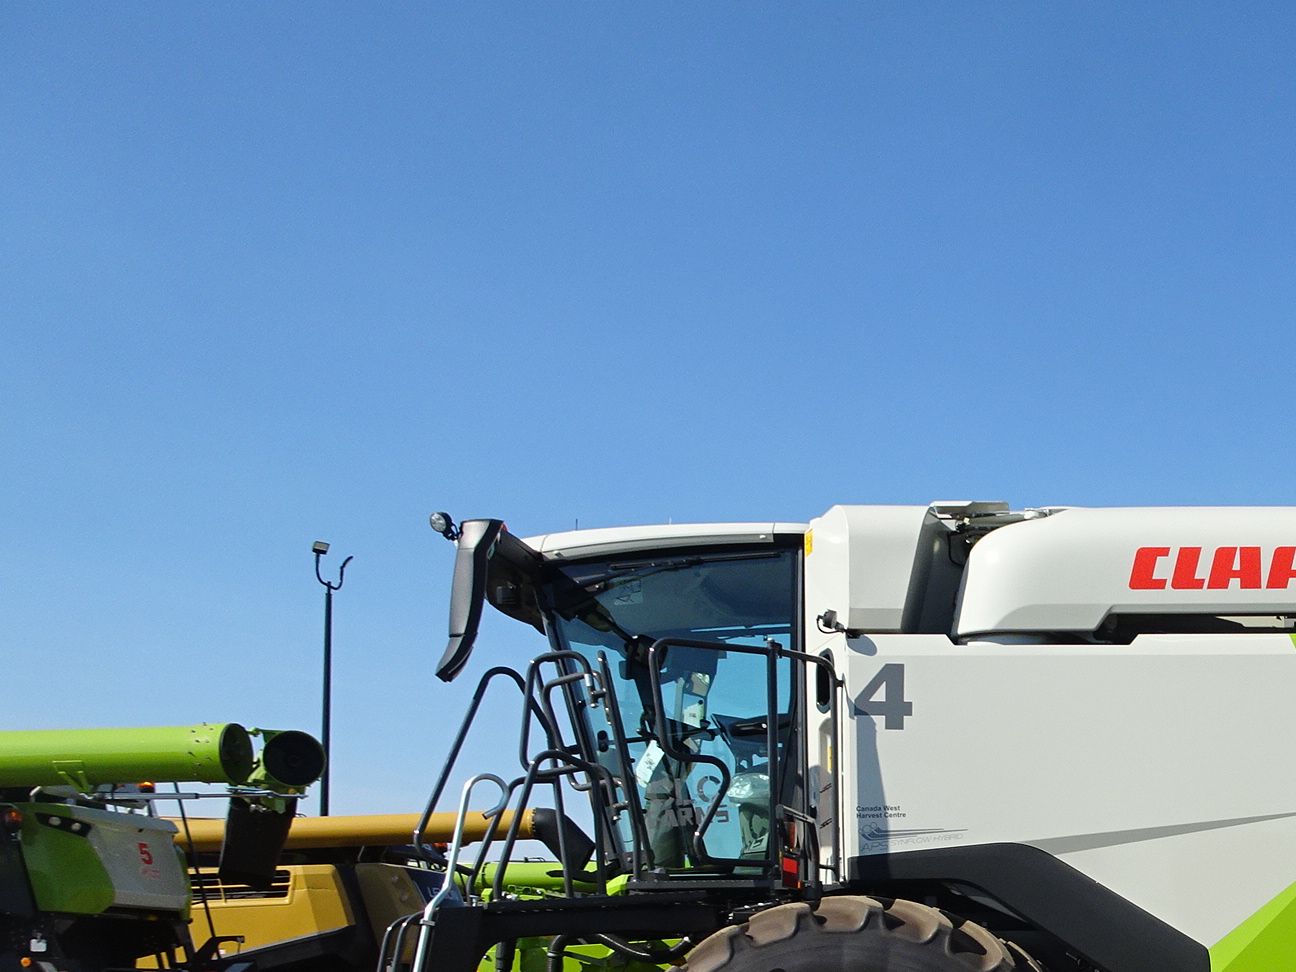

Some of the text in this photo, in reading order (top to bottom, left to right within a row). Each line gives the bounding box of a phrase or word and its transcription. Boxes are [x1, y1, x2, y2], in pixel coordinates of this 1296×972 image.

[854, 663, 913, 730] 4
[137, 842, 154, 866] 5
[861, 840, 889, 852] APS
